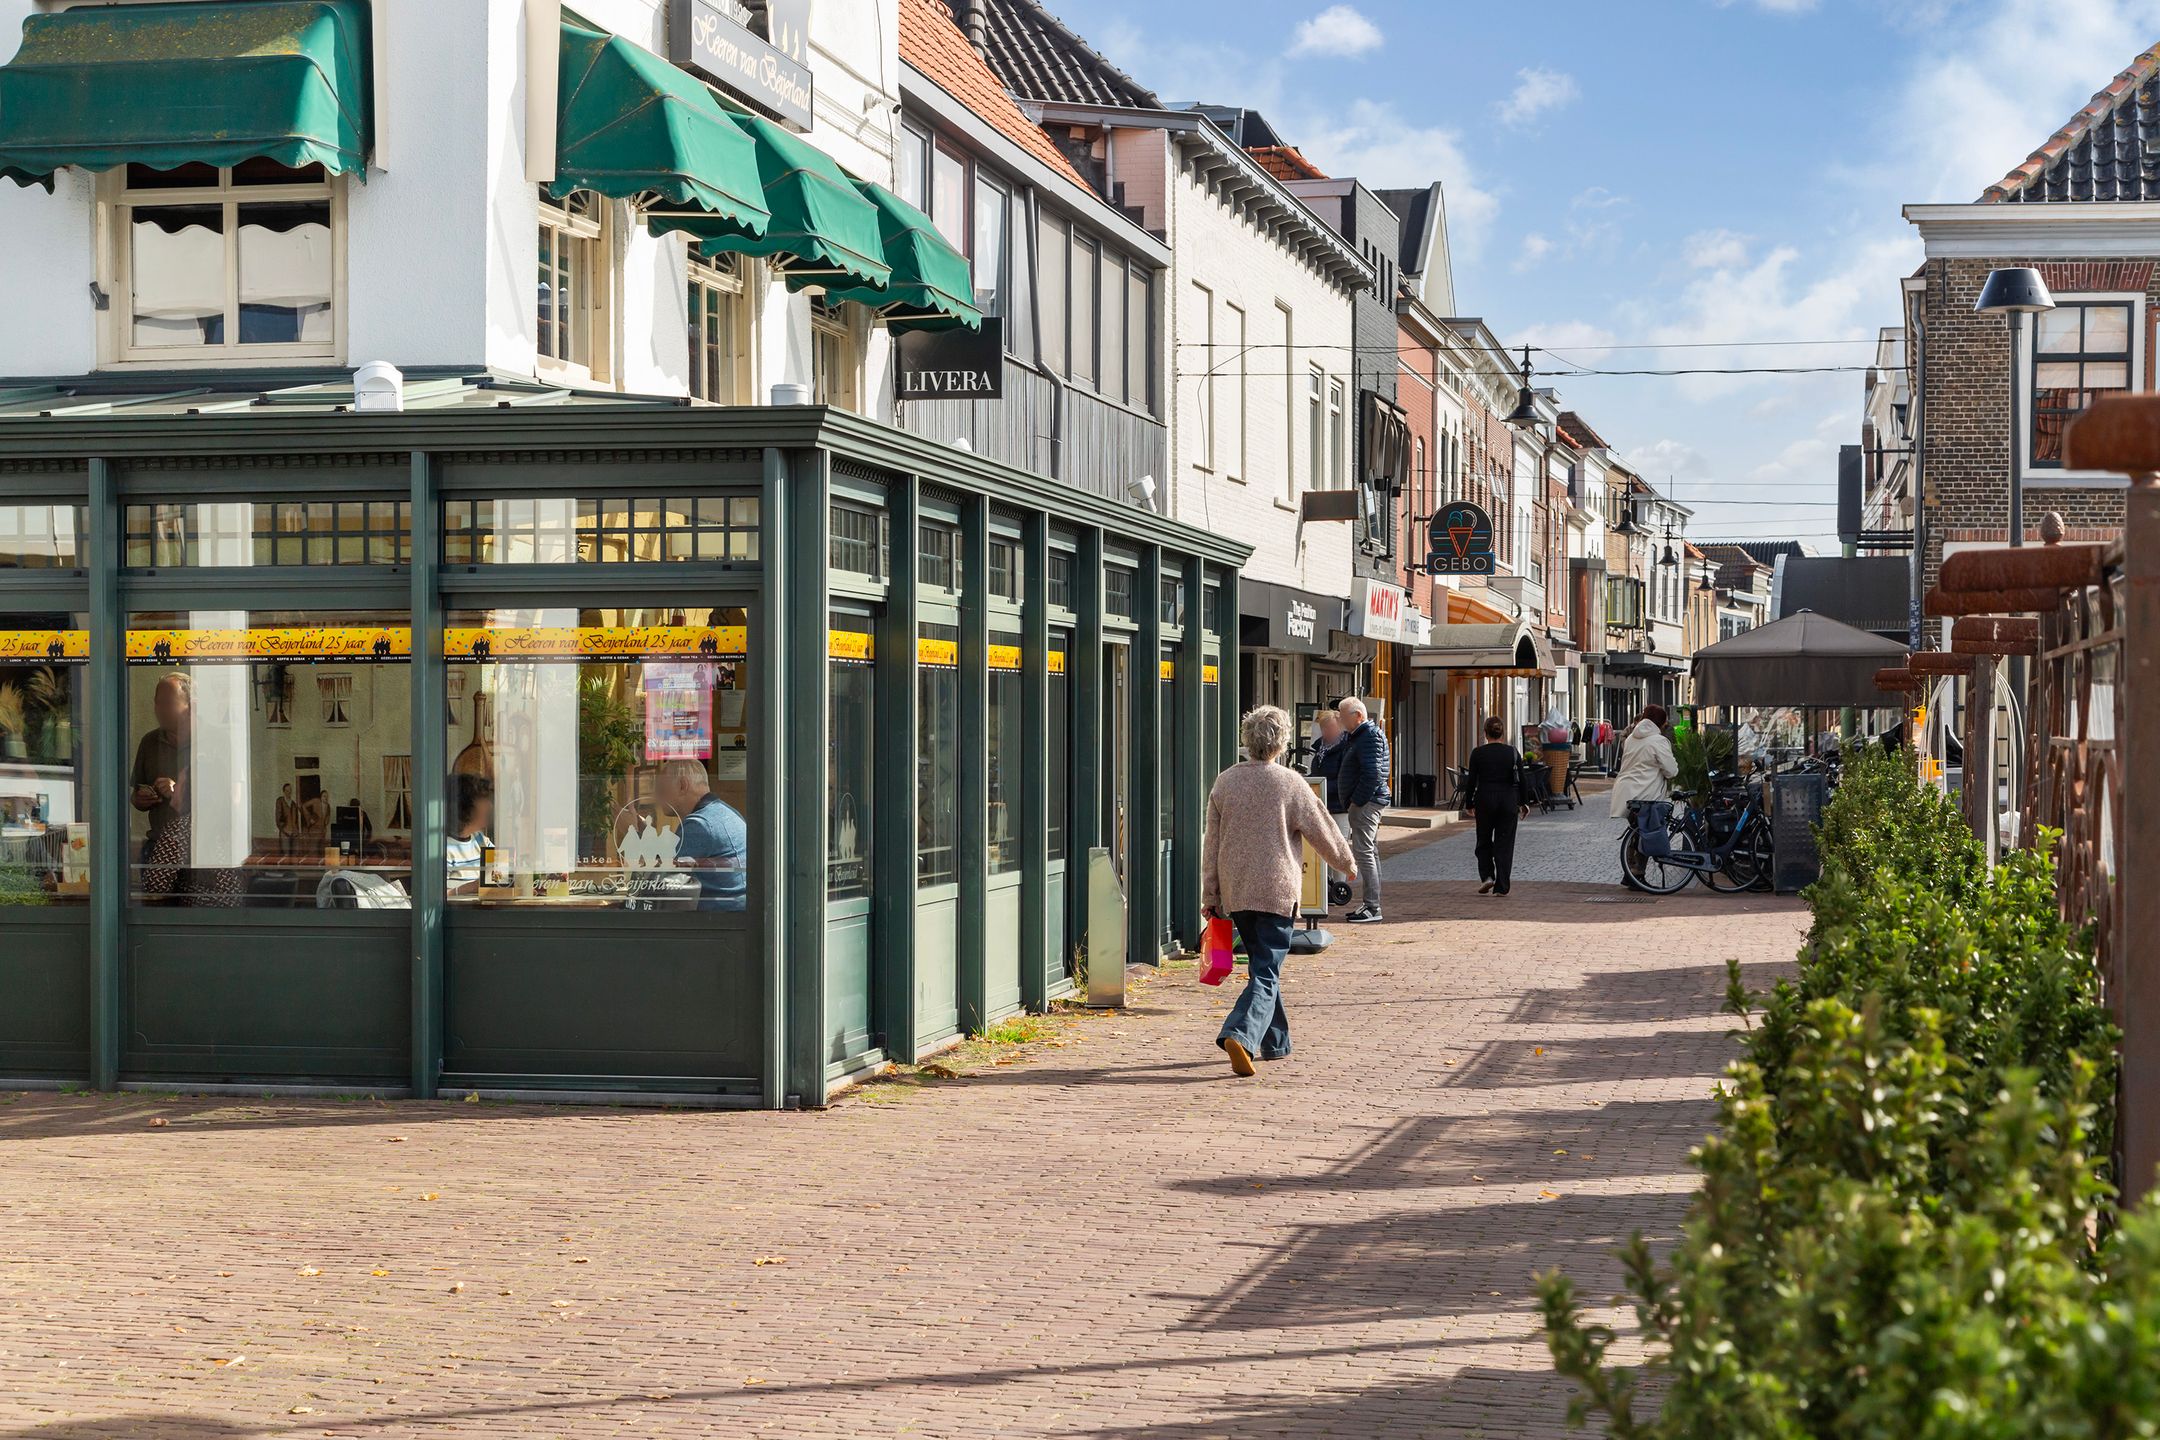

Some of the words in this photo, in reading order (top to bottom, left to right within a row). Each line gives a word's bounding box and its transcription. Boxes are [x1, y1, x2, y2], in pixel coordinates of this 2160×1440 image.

[693, 15, 737, 68] Heeren
[740, 51, 758, 79] van
[760, 52, 810, 112] Beijerland
[904, 370, 994, 392] LIVERA
[1434, 557, 1487, 571] GEBO
[1370, 586, 1399, 622] MARTIN'S
[2, 638, 18, 651] 25
[14, 640, 40, 655] jaar
[184, 636, 236, 650] Heeren
[238, 641, 256, 650] van
[260, 636, 325, 654] Beijerland
[326, 636, 342, 649] 25
[338, 640, 366, 653] jaar
[504, 634, 556, 649] Heeren
[558, 640, 579, 648] van
[583, 634, 650, 652] Beijerland
[650, 634, 668, 648] 25
[664, 638, 693, 652] jaar
